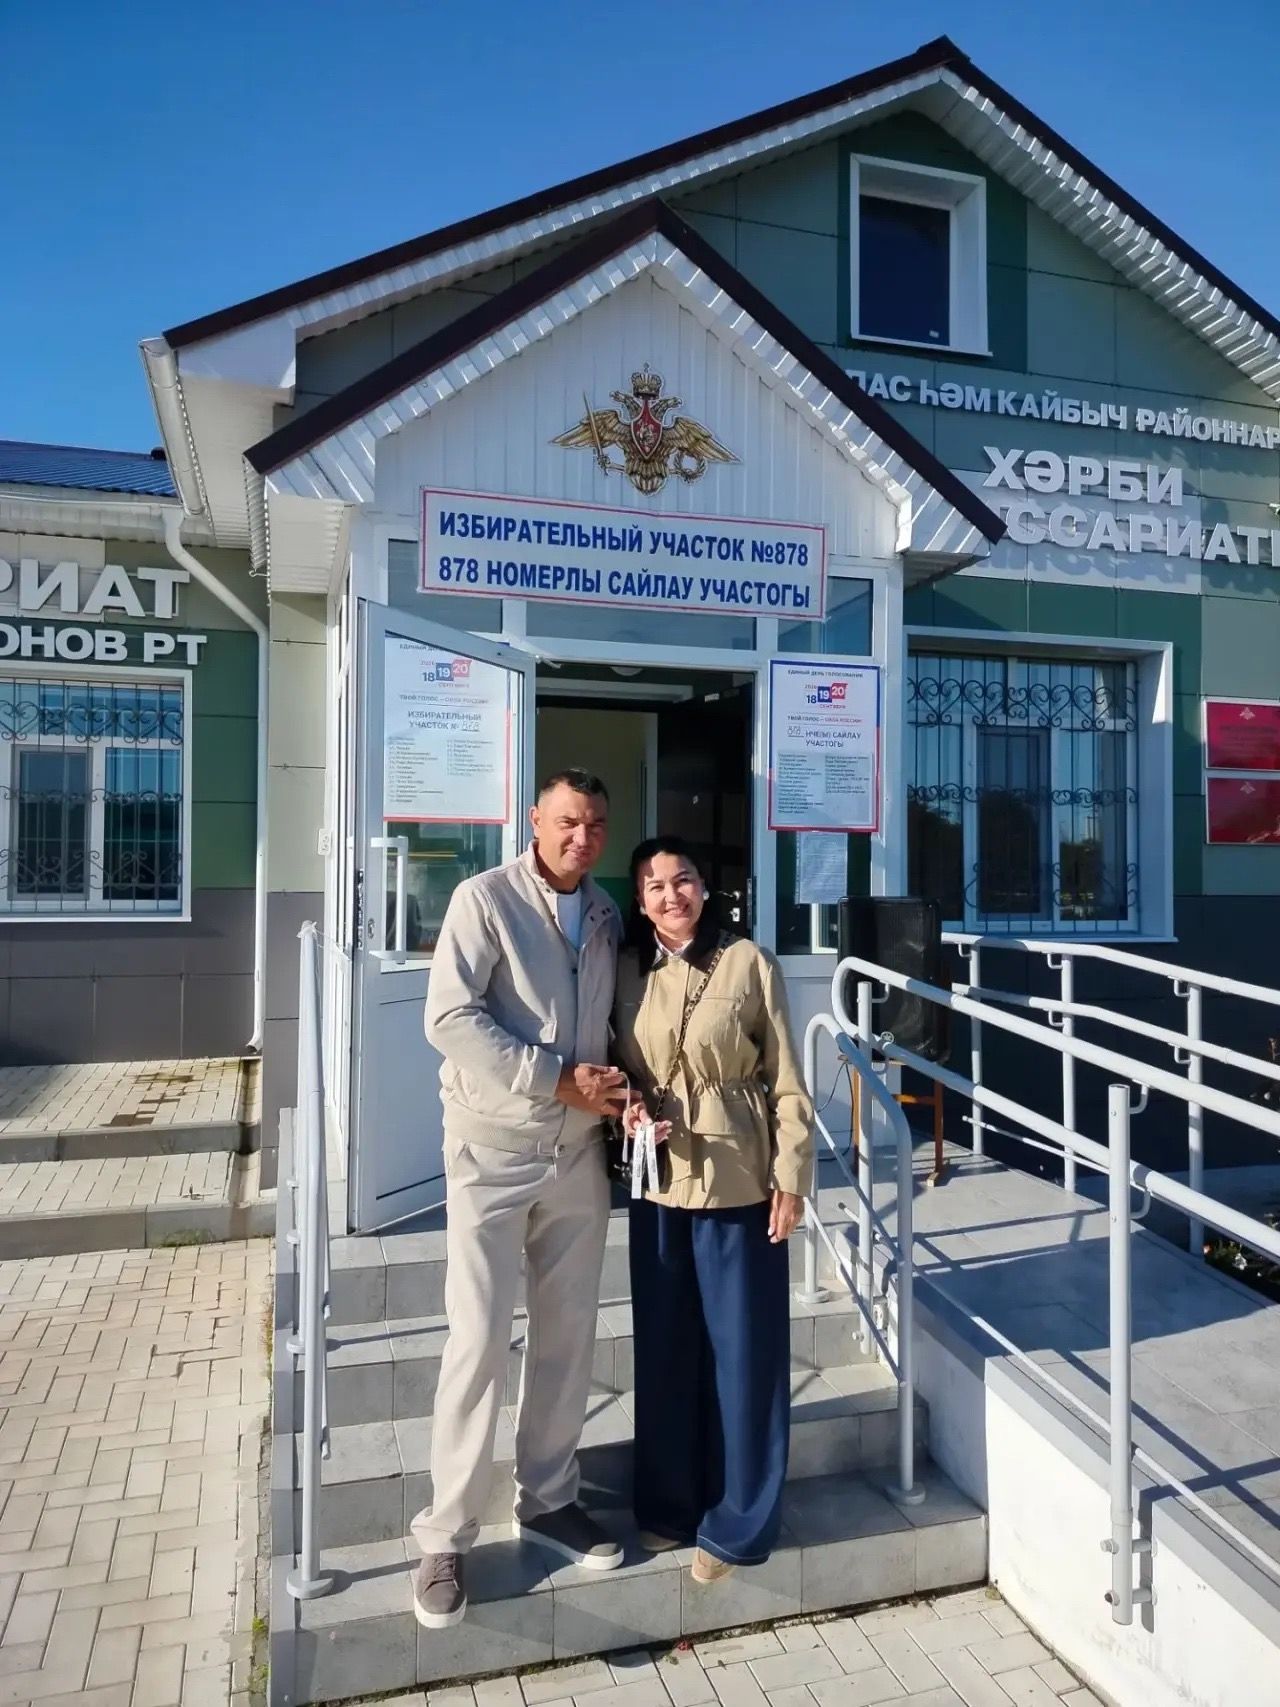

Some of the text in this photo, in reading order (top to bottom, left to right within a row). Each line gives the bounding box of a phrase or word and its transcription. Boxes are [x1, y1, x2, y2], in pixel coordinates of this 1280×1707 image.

[997, 389, 1127, 430] КАЙБЫЧ
[1136, 408, 1280, 449] РАЙОННАР
[982, 446, 1183, 506] ХӘРБИ
[439, 511, 809, 567] ИЗБИРАТЕЛЬНЫЙ УЧАСТОК №878
[1006, 500, 1280, 567] ССАРИАТ
[439, 556, 810, 608] 878 НОМЕРЛЫ САЙЛАУ УЧАСТОГЫ
[143, 632, 208, 665] РТ
[423, 663, 469, 681] 18 19 20
[806, 685, 845, 704] 18 19 20
[408, 710, 482, 721] ИЗБИРАТЕЛЬНЫЙ
[409, 720, 449, 729] УЧАСТОК
[805, 740, 844, 748] УЧАСТОГЫ
[832, 731, 862, 739] САЙЛАУ
